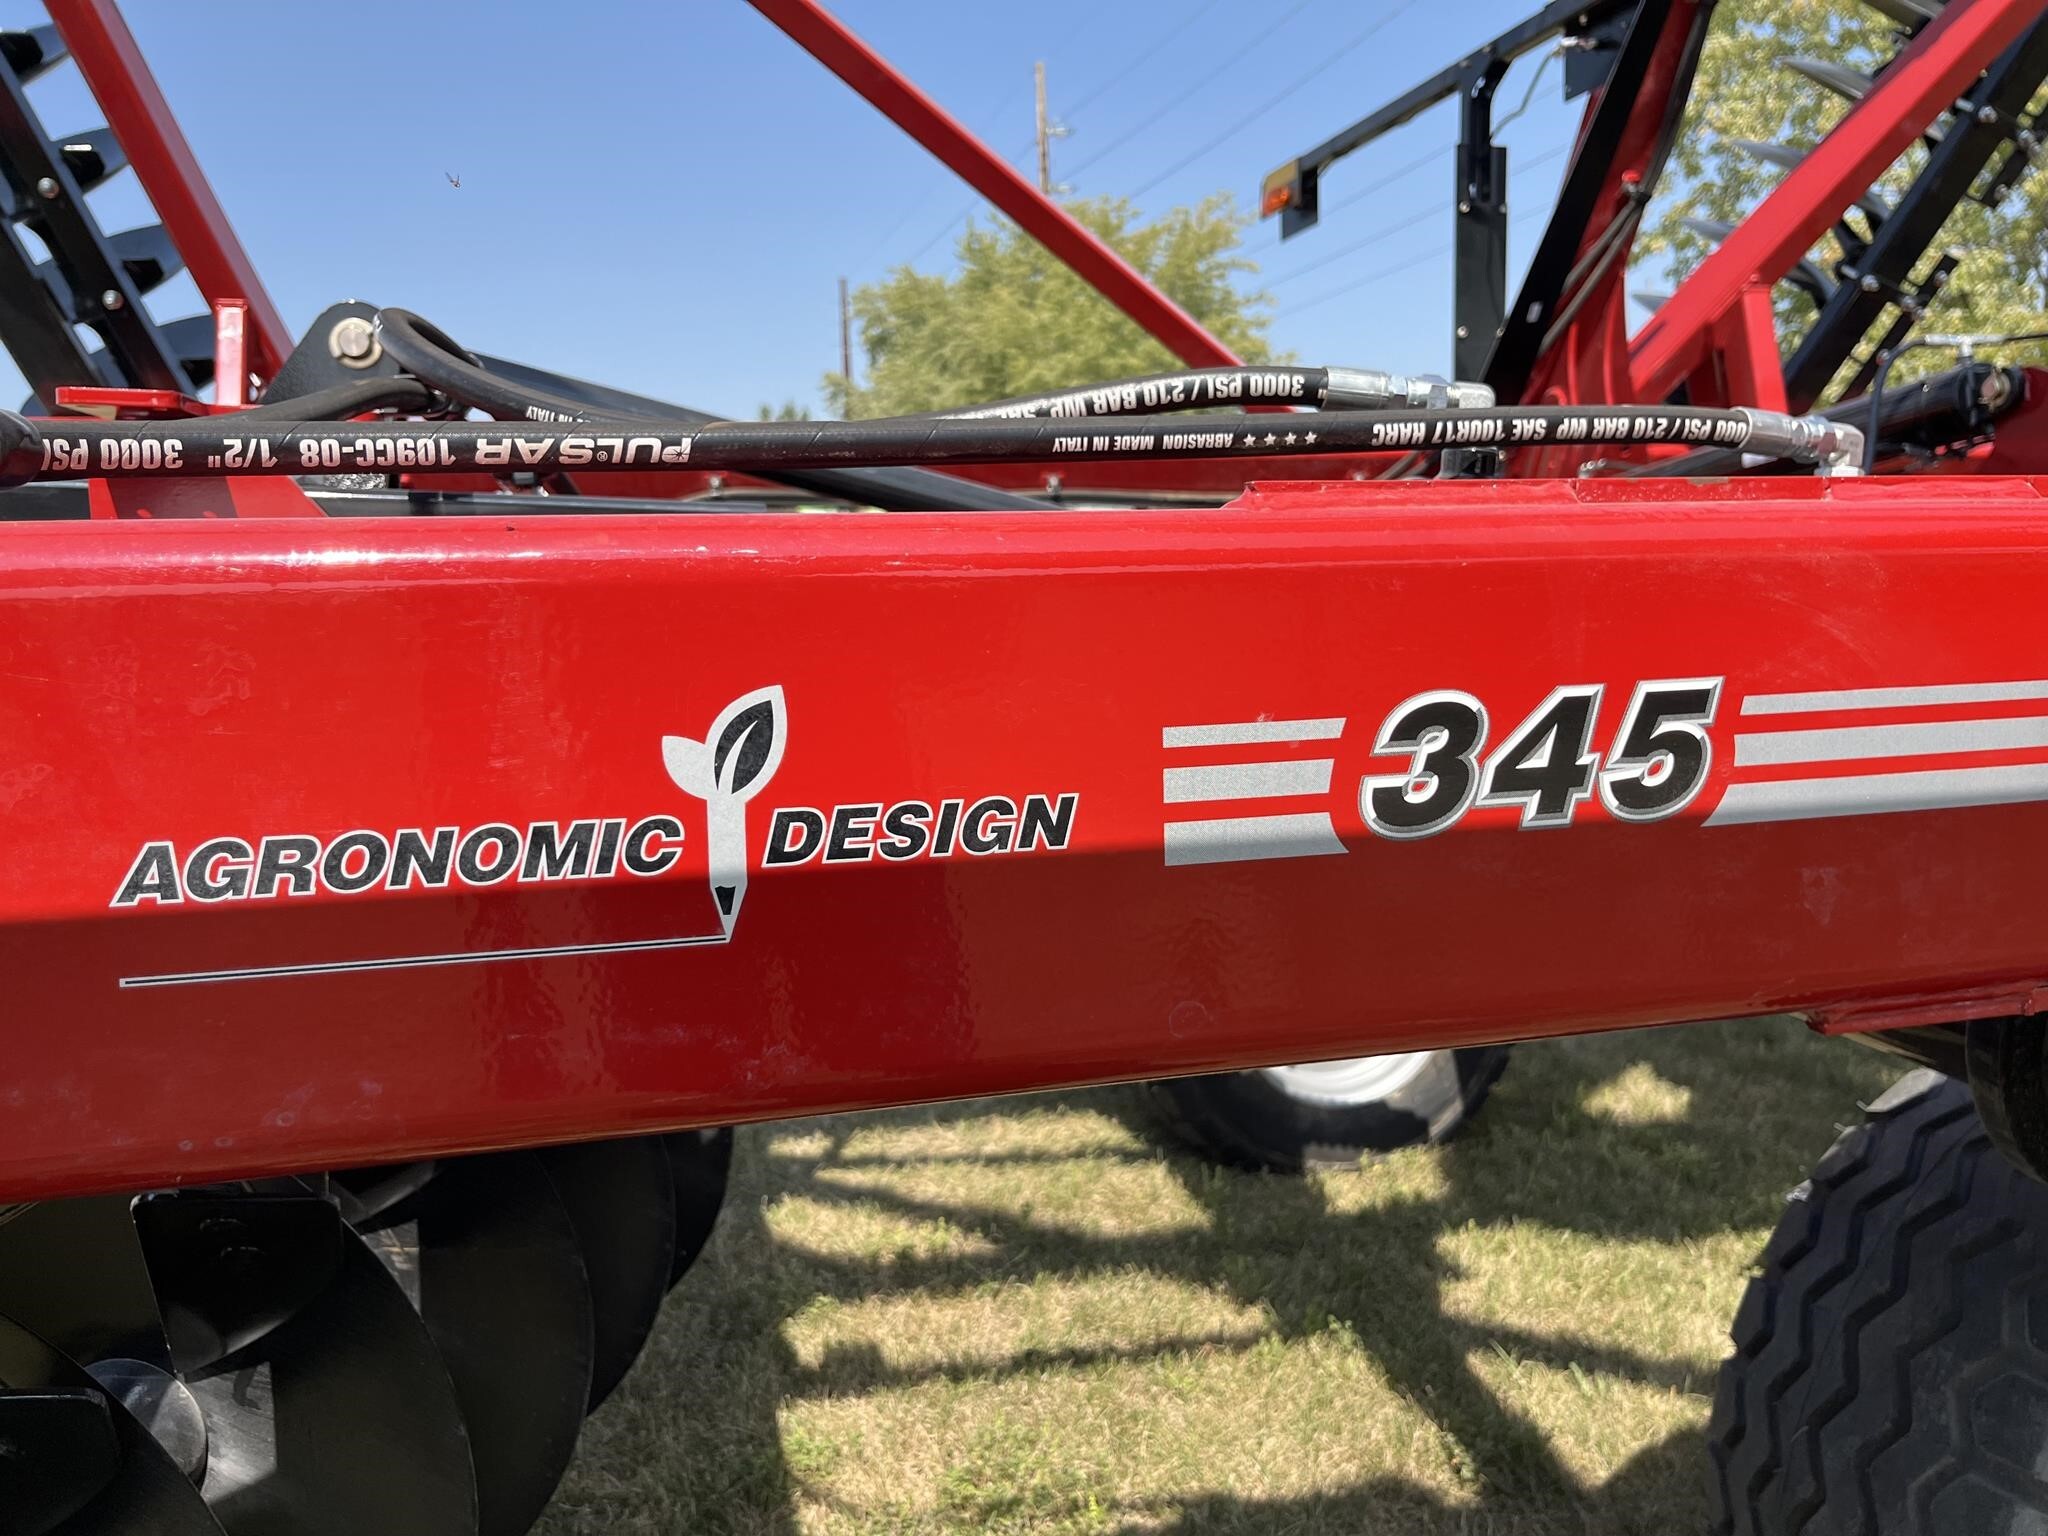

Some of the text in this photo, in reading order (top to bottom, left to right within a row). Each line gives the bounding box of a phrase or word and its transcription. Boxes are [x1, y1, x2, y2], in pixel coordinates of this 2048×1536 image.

[1143, 380, 1185, 407] 210
[1207, 374, 1243, 399] PSI
[1249, 375, 1305, 398] 3000
[1092, 385, 1138, 415] BAR
[526, 405, 556, 422] ITALY
[1372, 421, 1426, 447] HARC
[1431, 418, 1505, 445] 100R17
[1512, 418, 1546, 441] SAE
[1557, 417, 1591, 440] WP
[1592, 417, 1630, 440] BAR
[1632, 417, 1668, 440] 210
[1682, 418, 1712, 441] PSI
[101, 438, 183, 470] 3000
[208, 437, 277, 470] 1/2"
[300, 437, 456, 470] 109CC-08
[1052, 432, 1234, 453] ABRASION MADE IN ITALY
[1358, 676, 1726, 840] 345
[110, 793, 1078, 908] AGRONOMIC DESIGN
